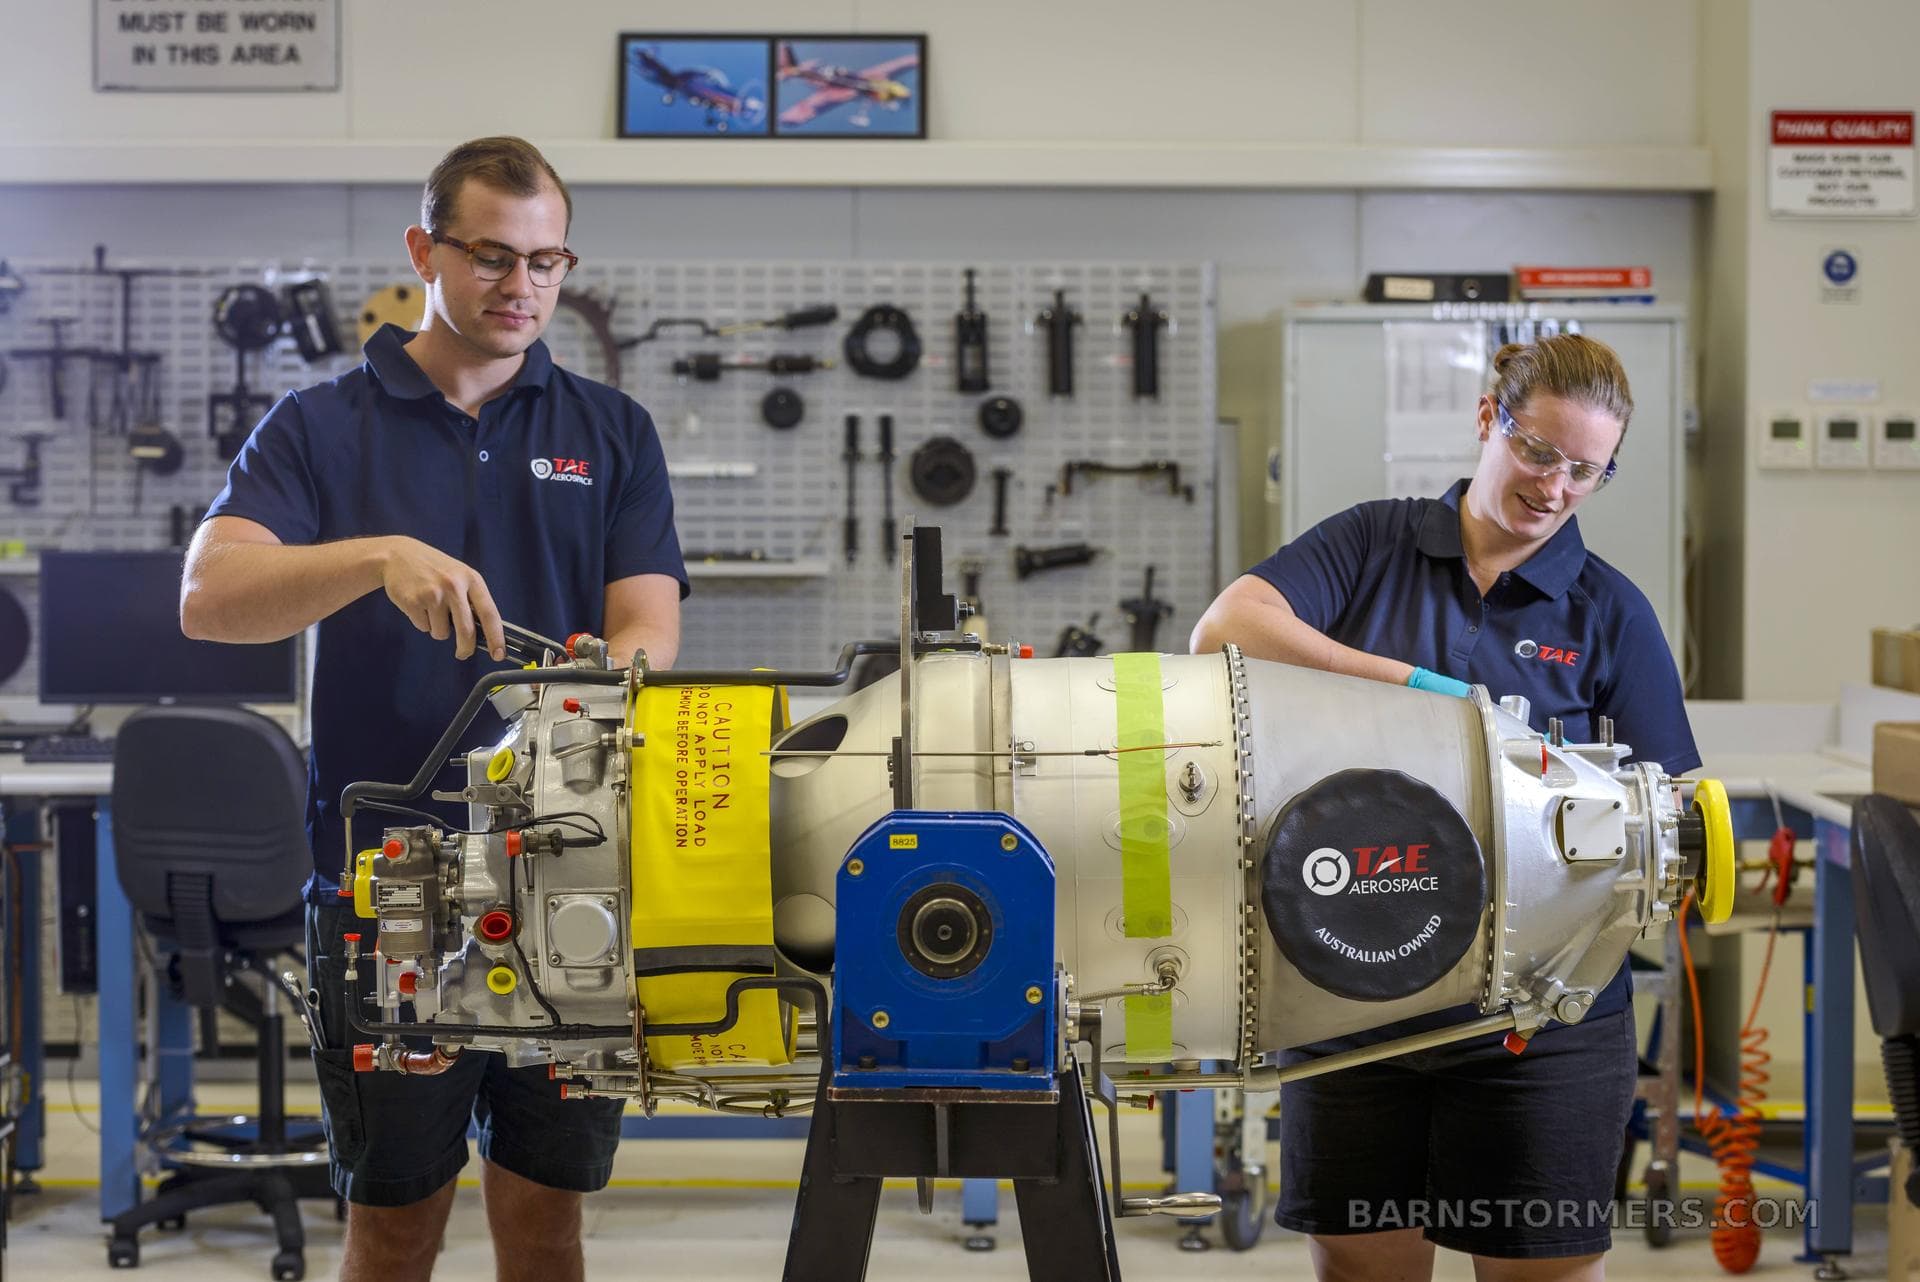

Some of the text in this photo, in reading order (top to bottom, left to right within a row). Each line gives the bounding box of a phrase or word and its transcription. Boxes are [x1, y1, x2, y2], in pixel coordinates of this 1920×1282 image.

[118, 12, 316, 32] MUST BE WORN
[132, 44, 301, 65] IN THIS AREA
[550, 472, 593, 486] AEROSPACE
[553, 458, 590, 476] TAE
[1539, 645, 1580, 666] TAE
[696, 702, 708, 726] NOT
[676, 720, 689, 764] BEFORE
[712, 702, 733, 810] CAUTION
[694, 734, 706, 788] APPLY
[675, 770, 688, 848] OPERATION
[694, 800, 706, 847] LOAD
[1352, 844, 1430, 879] TAE
[1348, 876, 1439, 895] AEROSPACE
[1315, 914, 1442, 963] AUSTRALIAN OWNED
